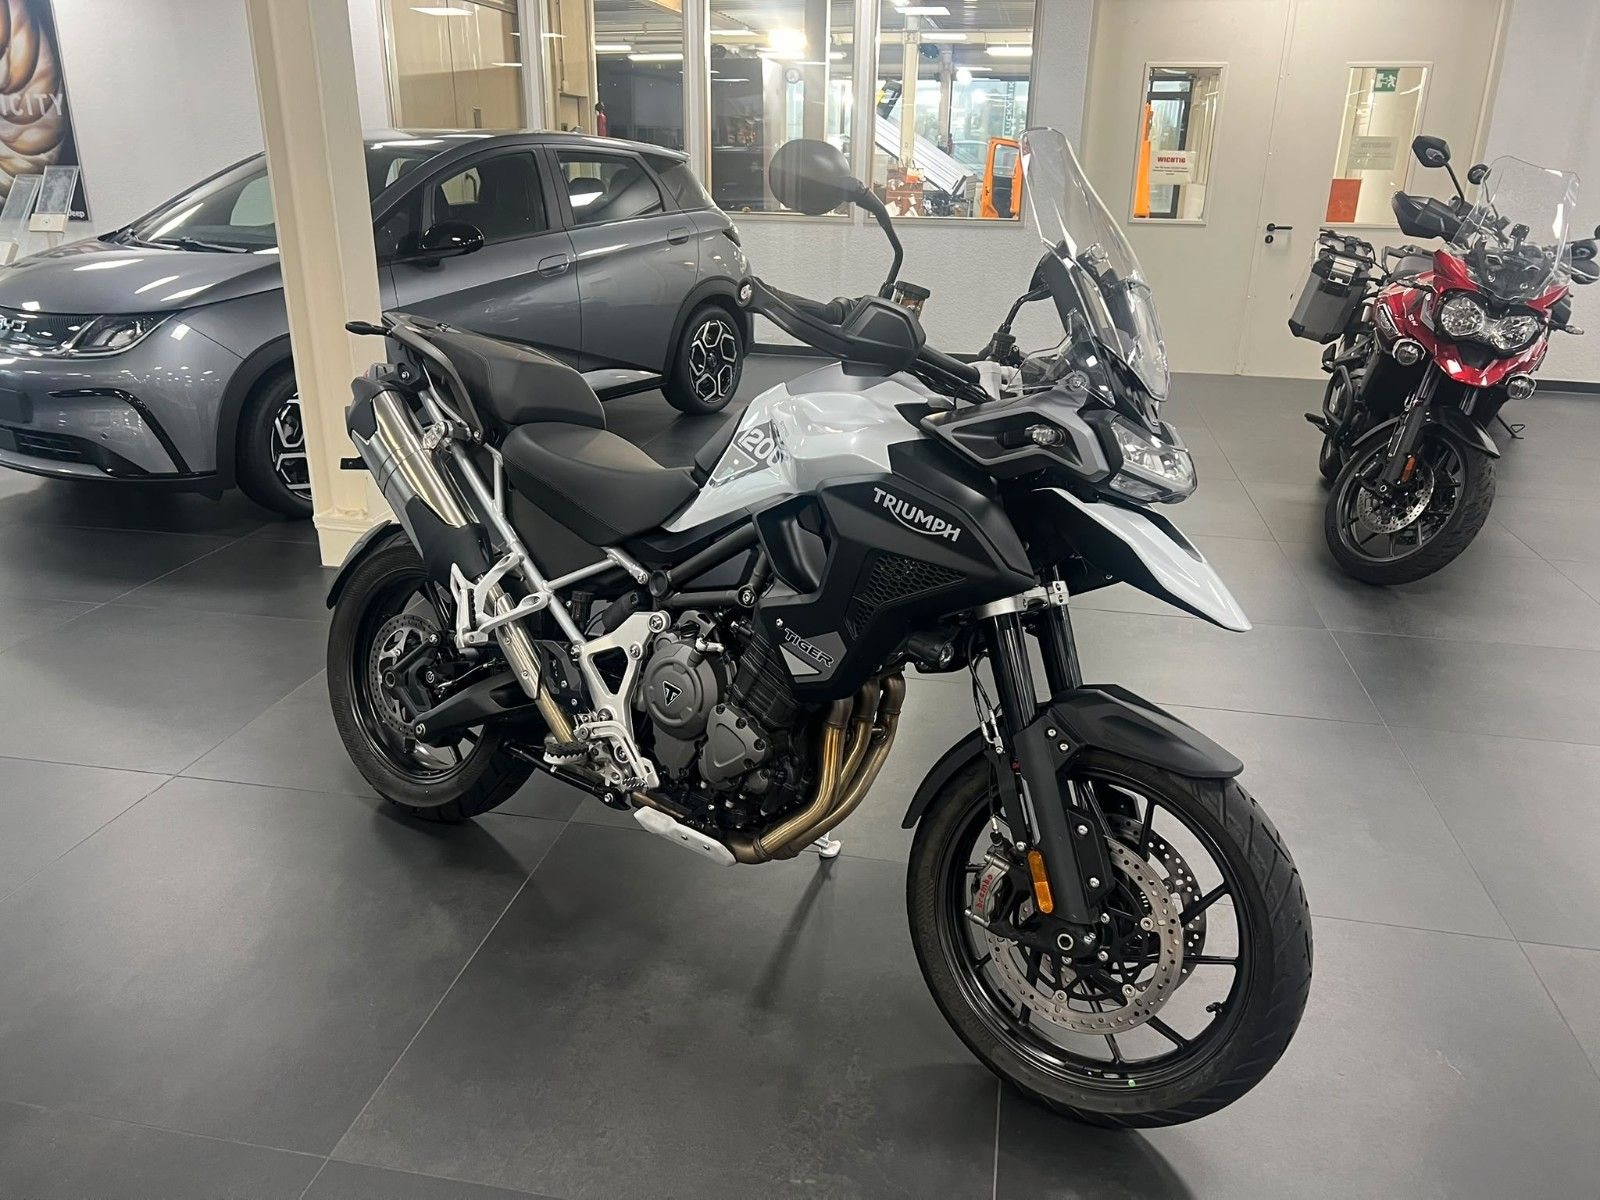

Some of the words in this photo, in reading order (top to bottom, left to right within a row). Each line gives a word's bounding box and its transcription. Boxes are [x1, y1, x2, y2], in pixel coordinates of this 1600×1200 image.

[873, 486, 961, 542] TRIUMPH
[784, 627, 835, 668] TIGER
[976, 874, 993, 909] brembo
